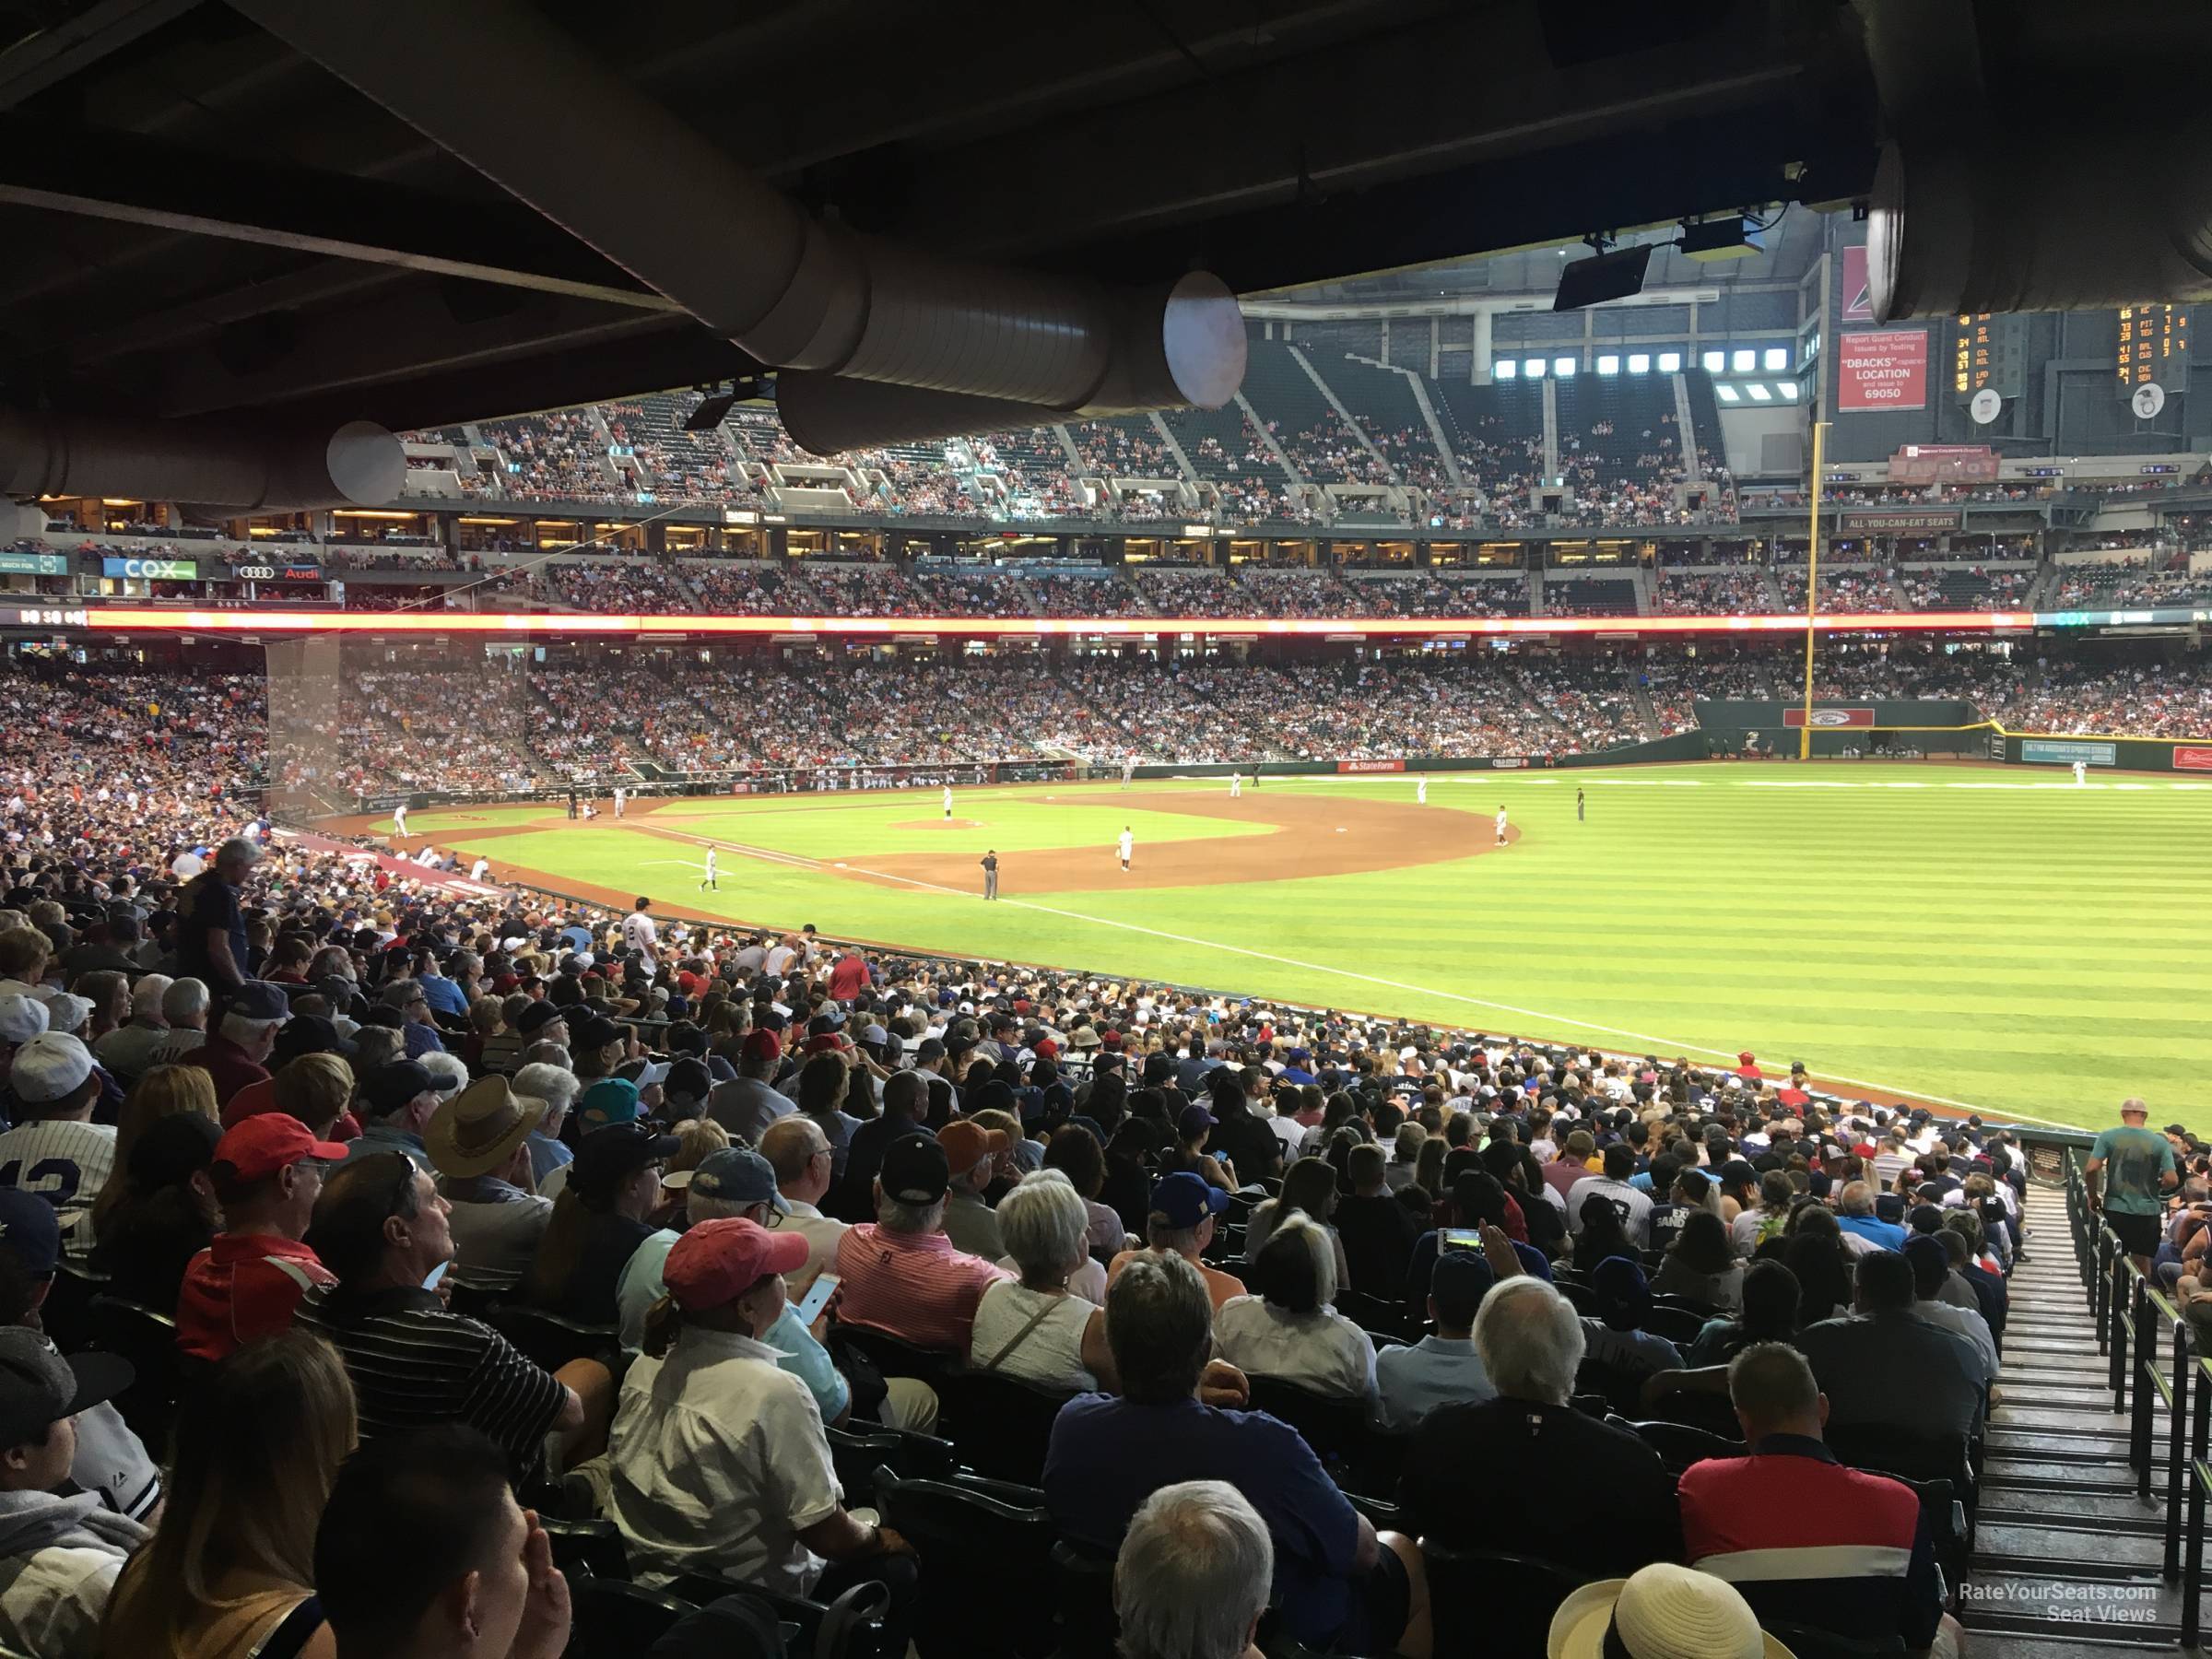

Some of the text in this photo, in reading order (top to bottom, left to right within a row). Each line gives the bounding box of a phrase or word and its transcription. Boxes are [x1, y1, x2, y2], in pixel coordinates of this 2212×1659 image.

[2140, 320, 2153, 328] PIT
[2165, 315, 2171, 324] 7
[2164, 325, 2171, 334] 5
[2163, 347, 2170, 357] 3
[1856, 369, 1911, 380] LOCATION
[2123, 376, 2128, 384] 7
[1865, 389, 1900, 399] 69050
[1849, 517, 1954, 528] ALL-YOU-CAN-EAT SEATS
[124, 559, 176, 578] COX
[285, 568, 319, 580] Audi
[2055, 611, 2090, 626] COX
[629, 925, 635, 941] 2
[880, 1250, 893, 1264] FJ
